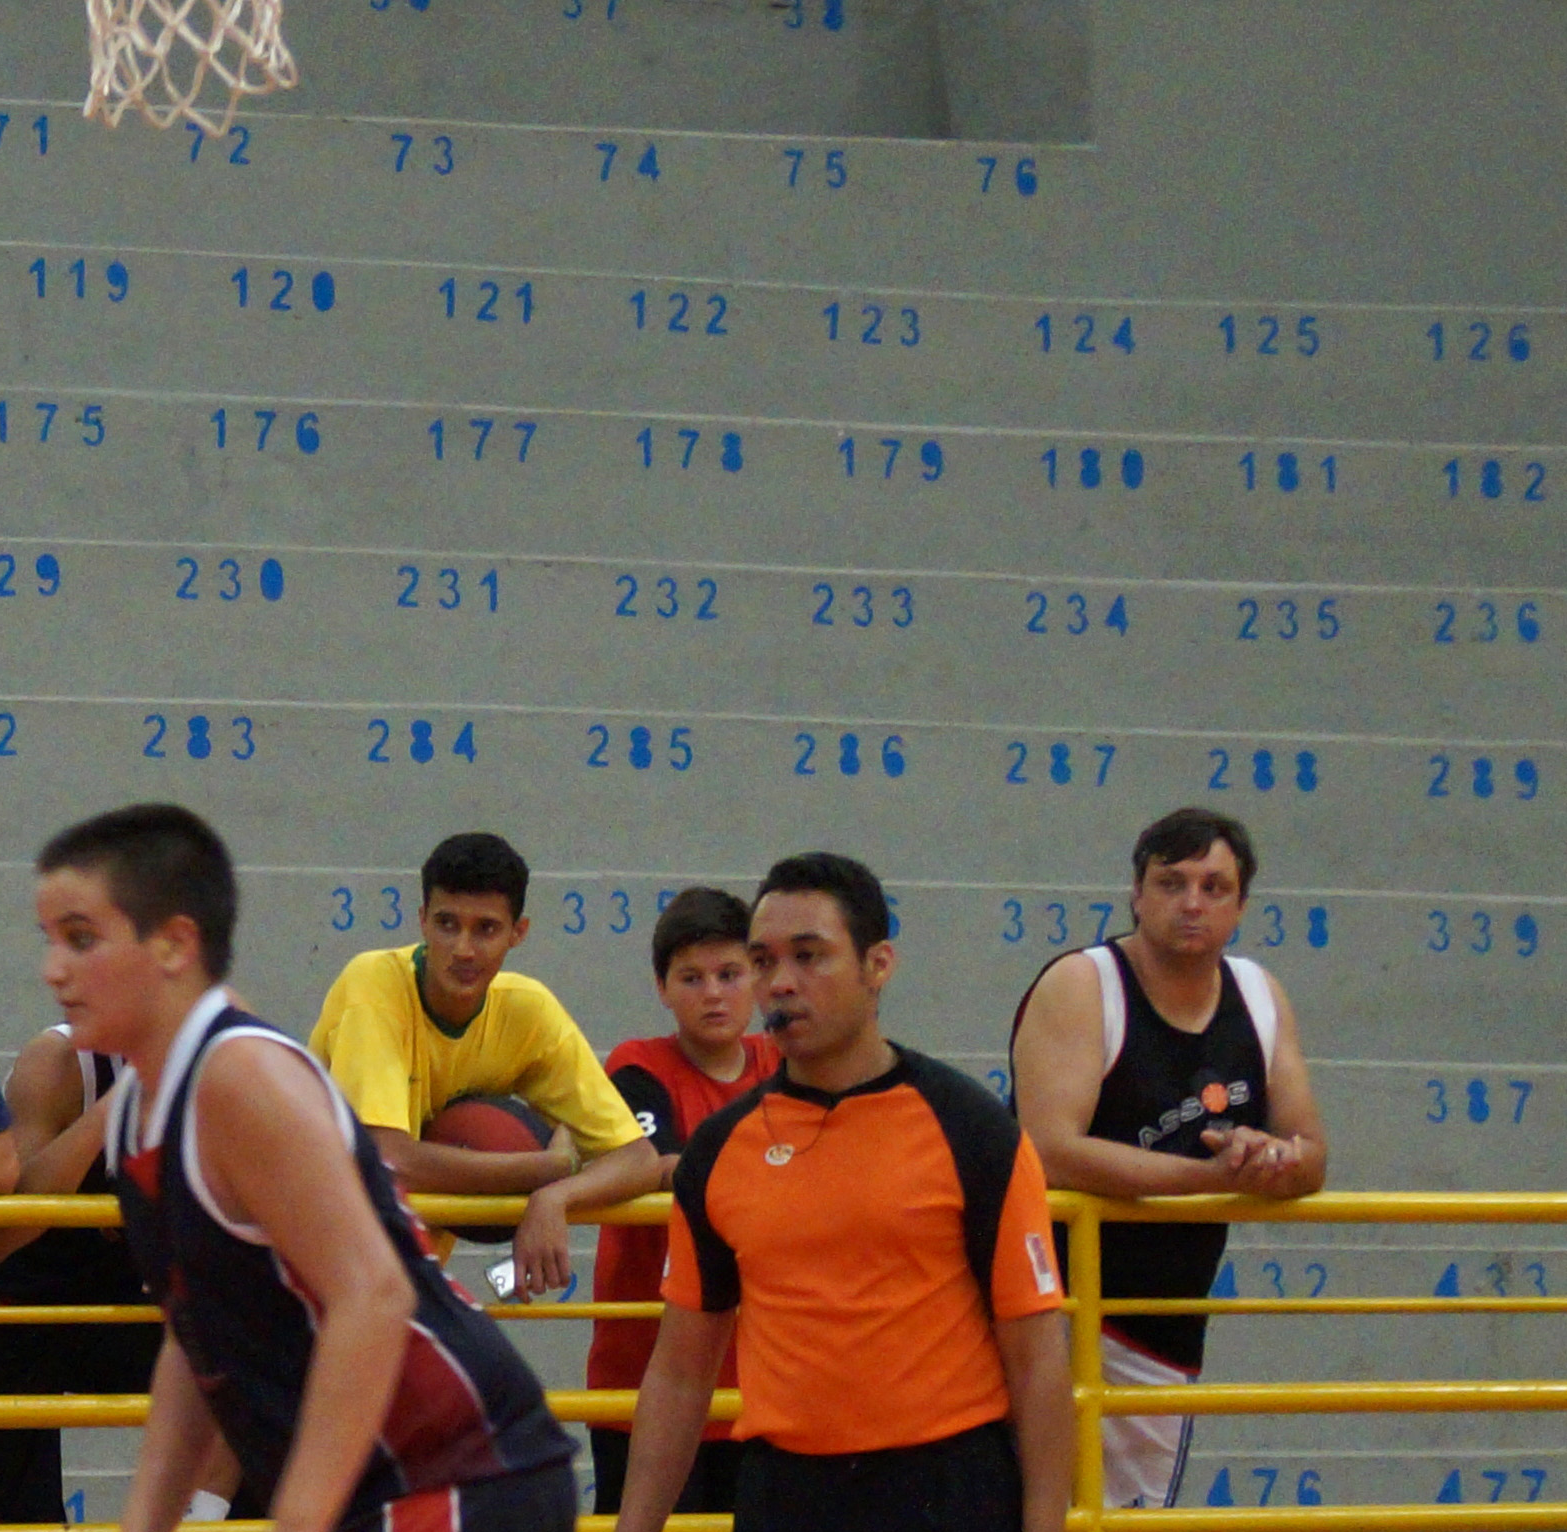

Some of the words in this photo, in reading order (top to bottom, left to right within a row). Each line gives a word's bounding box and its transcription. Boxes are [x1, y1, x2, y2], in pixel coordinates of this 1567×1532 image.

[185, 123, 252, 165] 72
[391, 133, 455, 175] 73
[596, 142, 662, 181] 74
[783, 149, 848, 189] 75
[978, 157, 1039, 196] 76
[28, 257, 131, 303] 119
[231, 267, 336, 313] 120
[438, 278, 534, 324] 121
[629, 290, 728, 336] 122
[822, 303, 921, 347] 123
[1035, 314, 1136, 354] 124
[1218, 315, 1320, 356] 125
[1428, 323, 1531, 362] 126
[210, 408, 322, 455] 176
[427, 419, 538, 462] 177
[635, 427, 745, 473] 178
[838, 437, 945, 482] 179
[1041, 447, 1145, 490] 180
[1239, 452, 1337, 493] 181
[1443, 459, 1547, 502] 182
[174, 556, 286, 602] 230
[396, 565, 500, 612] 231
[614, 574, 719, 621] 232
[811, 582, 915, 628] 233
[1025, 592, 1130, 635] 234
[1238, 598, 1341, 640] 235
[1434, 602, 1542, 644] 236
[142, 714, 257, 761] 283
[366, 718, 479, 764] 284
[585, 723, 695, 772] 285
[792, 732, 908, 778] 286
[1005, 742, 1117, 786] 287
[1207, 748, 1319, 793] 288
[1427, 756, 1540, 801] 289
[331, 886, 405, 931] 33
[562, 889, 677, 935] 33
[1001, 898, 1115, 947] 337
[1228, 905, 1331, 949] 38
[1429, 910, 1539, 958] 339
[1426, 1078, 1533, 1124] 387
